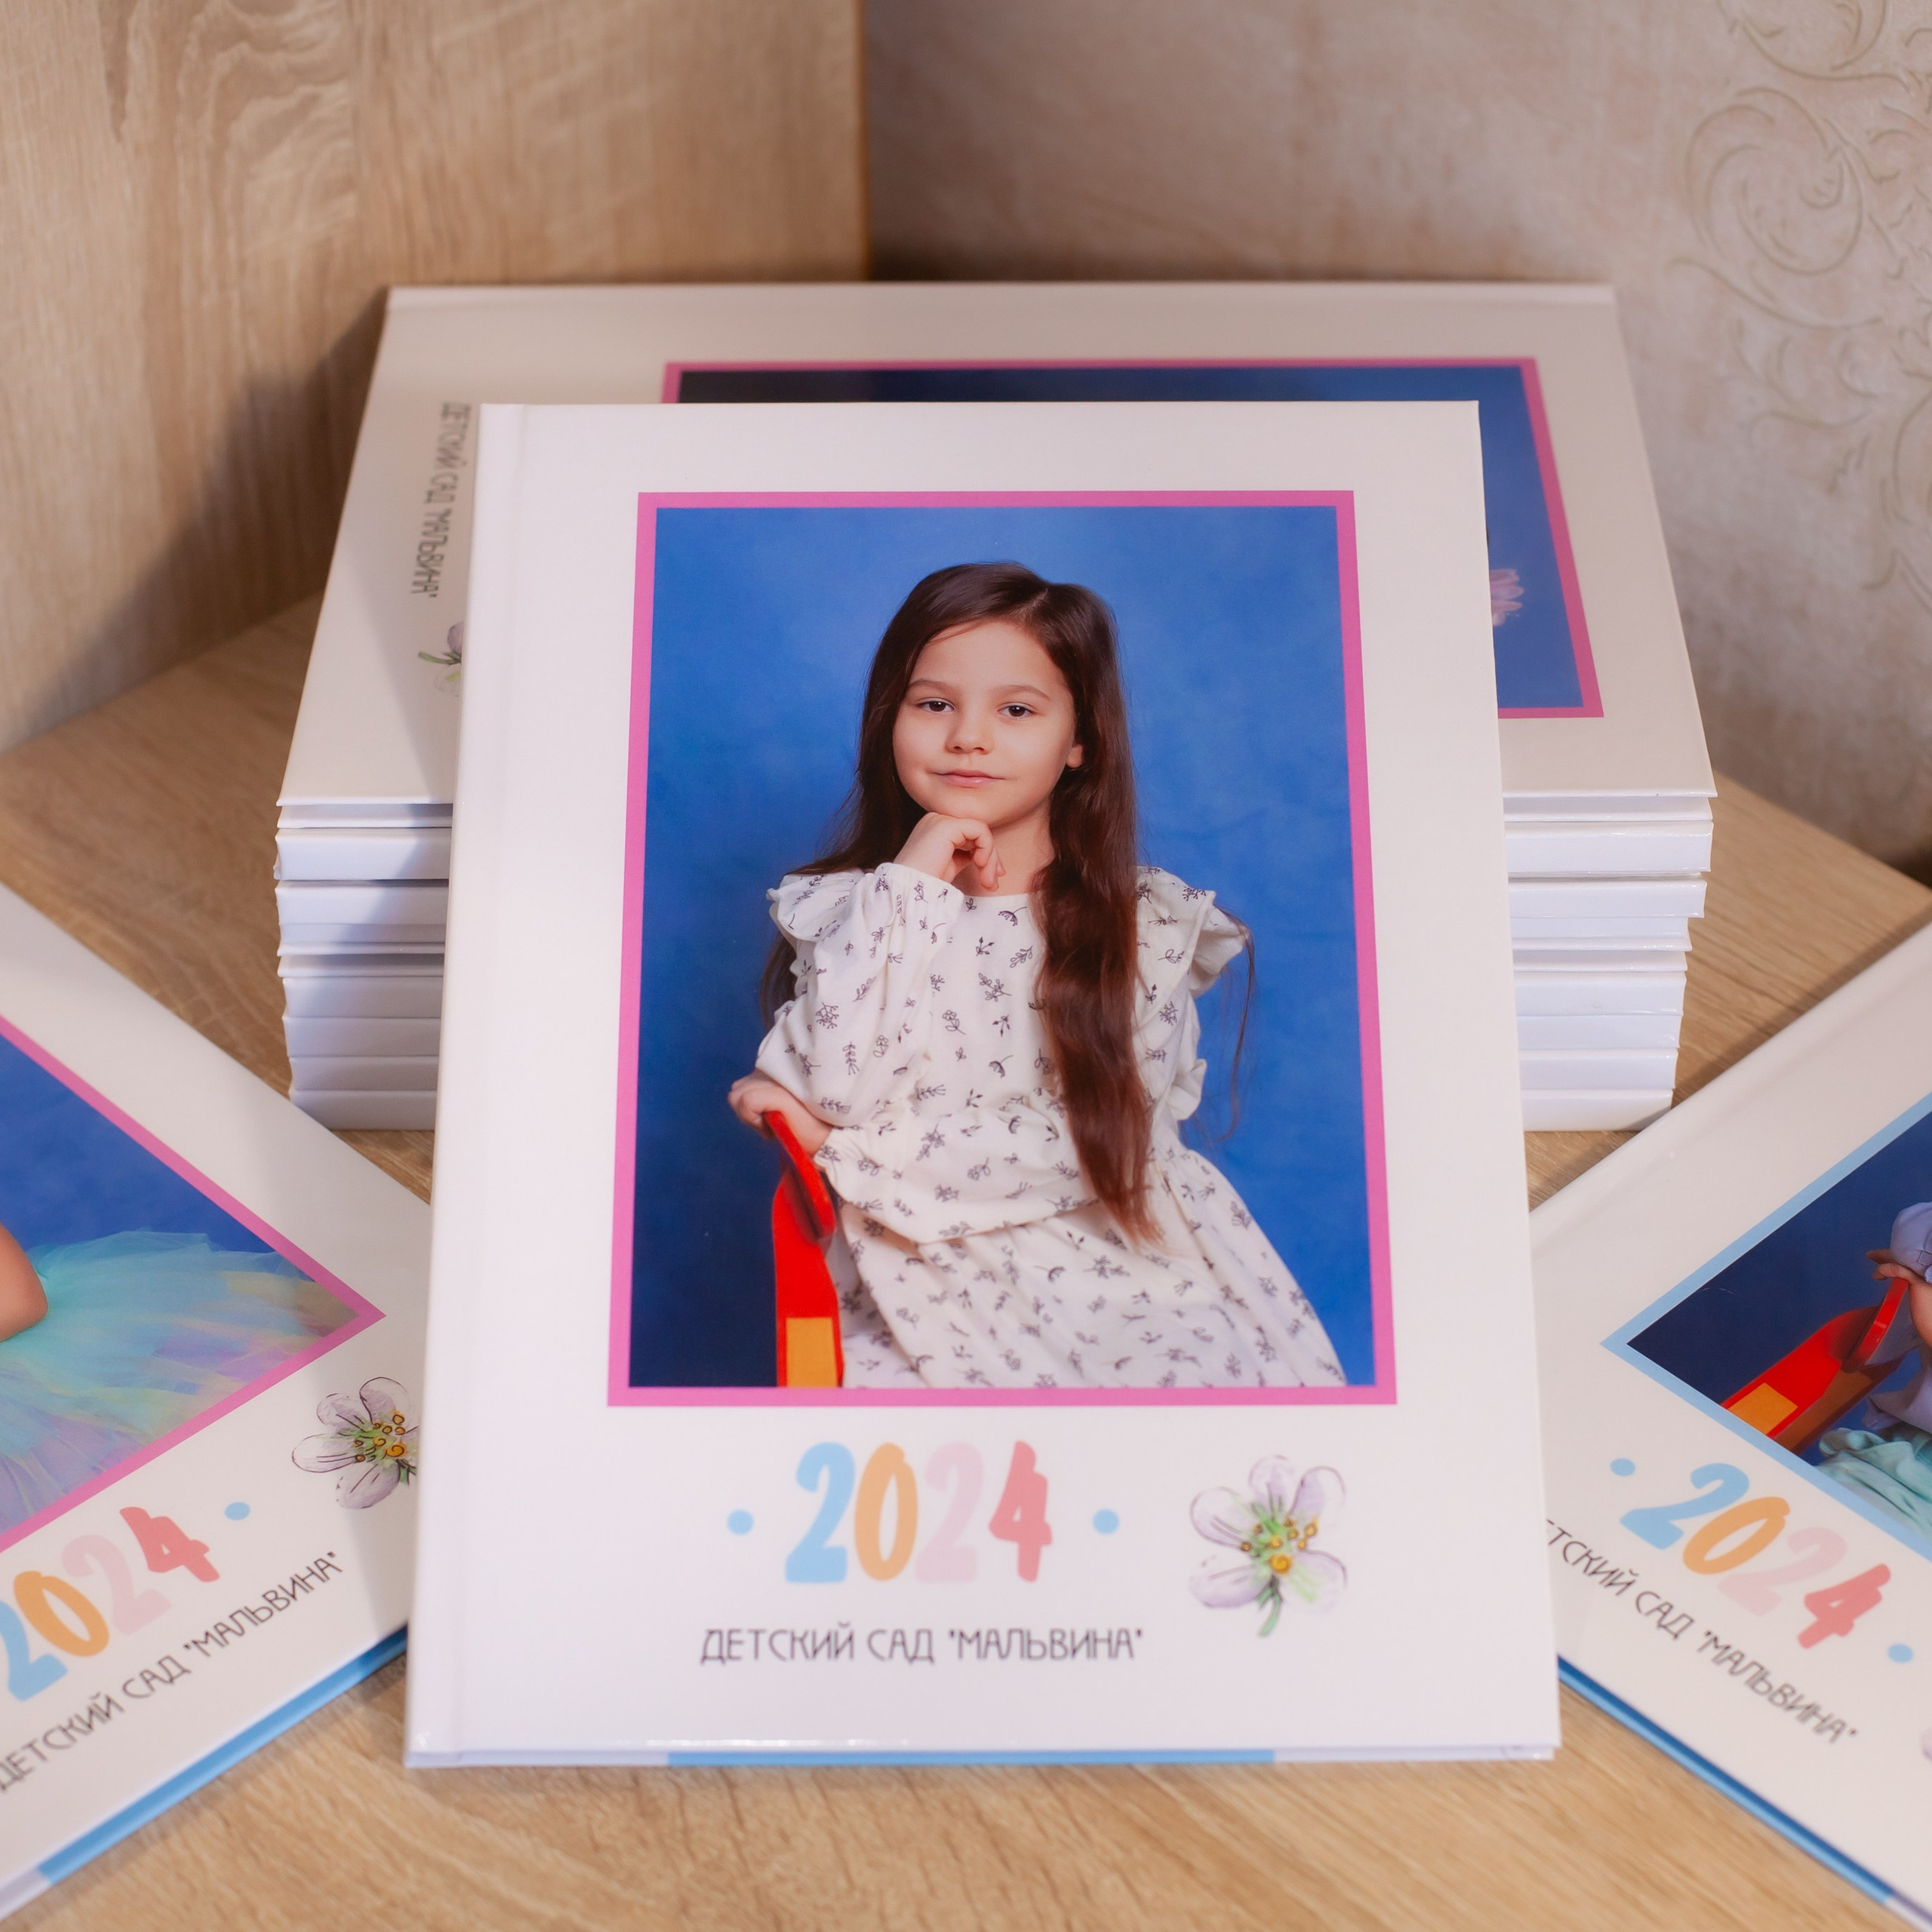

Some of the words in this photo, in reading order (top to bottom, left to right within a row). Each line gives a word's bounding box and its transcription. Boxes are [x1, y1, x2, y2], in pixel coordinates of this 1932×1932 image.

[424, 472, 458, 503] САД
[784, 1440, 1053, 1583] 2024
[1546, 1518, 1639, 1597] ТСКИЙ
[1635, 1590, 1695, 1641] САД
[1619, 1462, 1891, 1649] 2024
[122, 1654, 192, 1701] САД
[700, 1621, 855, 1666] ДЕТСКИЙ
[866, 1629, 936, 1666] САД
